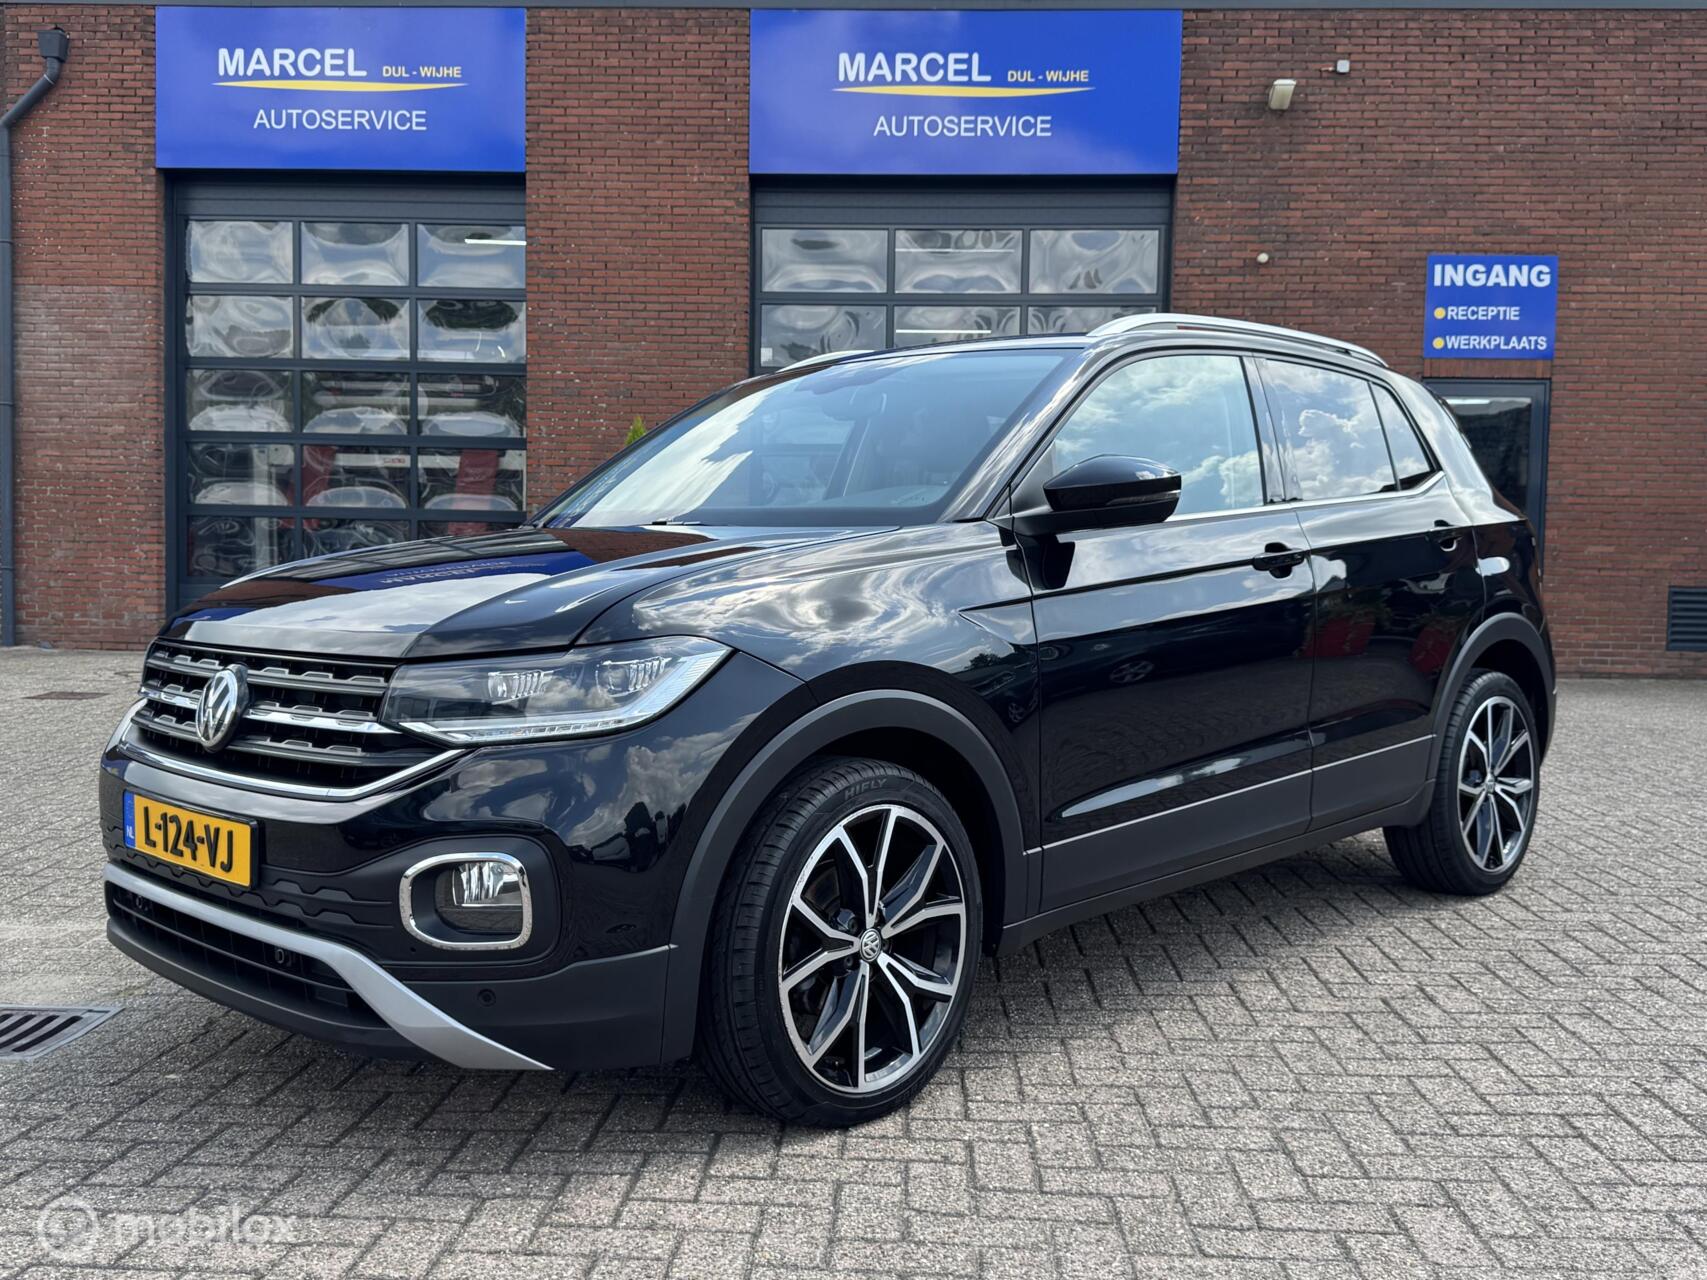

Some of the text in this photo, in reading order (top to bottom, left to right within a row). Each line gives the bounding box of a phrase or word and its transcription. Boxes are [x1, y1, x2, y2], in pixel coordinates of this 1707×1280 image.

[217, 47, 368, 77] MARCEL
[382, 66, 411, 78] DUL
[419, 66, 462, 79] WIJHE
[837, 52, 992, 82] MARCEL
[1007, 70, 1035, 83] DUL
[1045, 70, 1089, 83] WIJHE
[253, 109, 428, 131] AUTOSERVICE
[873, 115, 1053, 137] AUTOSERVICE
[1433, 263, 1552, 288] INGANG
[1447, 305, 1521, 321] RECEPTIE
[1445, 335, 1548, 351] WERKPLAATS
[844, 778, 888, 800] HIFLY
[143, 805, 234, 873] L-124-VJ
